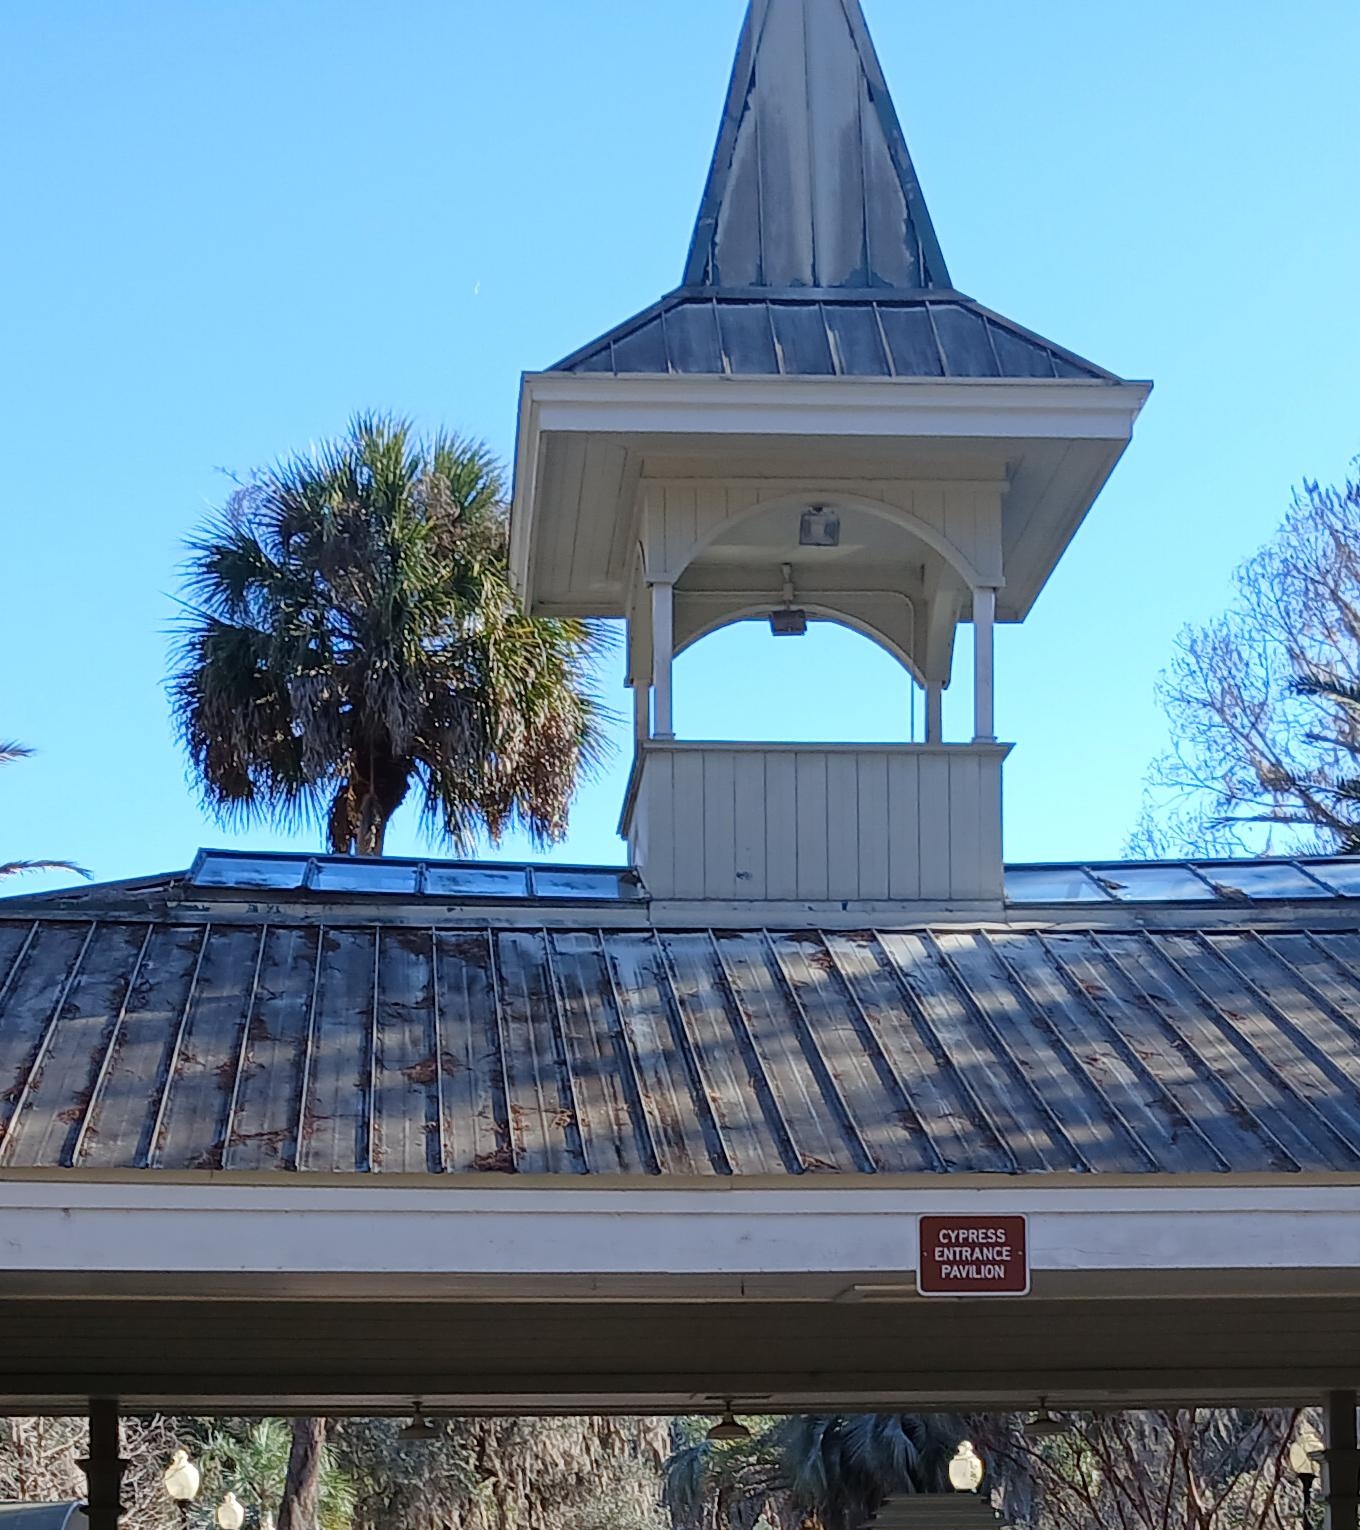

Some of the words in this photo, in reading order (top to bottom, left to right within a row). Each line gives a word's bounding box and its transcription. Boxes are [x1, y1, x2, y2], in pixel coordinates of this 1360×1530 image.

[939, 1228, 1006, 1244] CYPRESS
[934, 1246, 1011, 1261] ENTRANCE
[941, 1264, 1005, 1279] PAVILION
